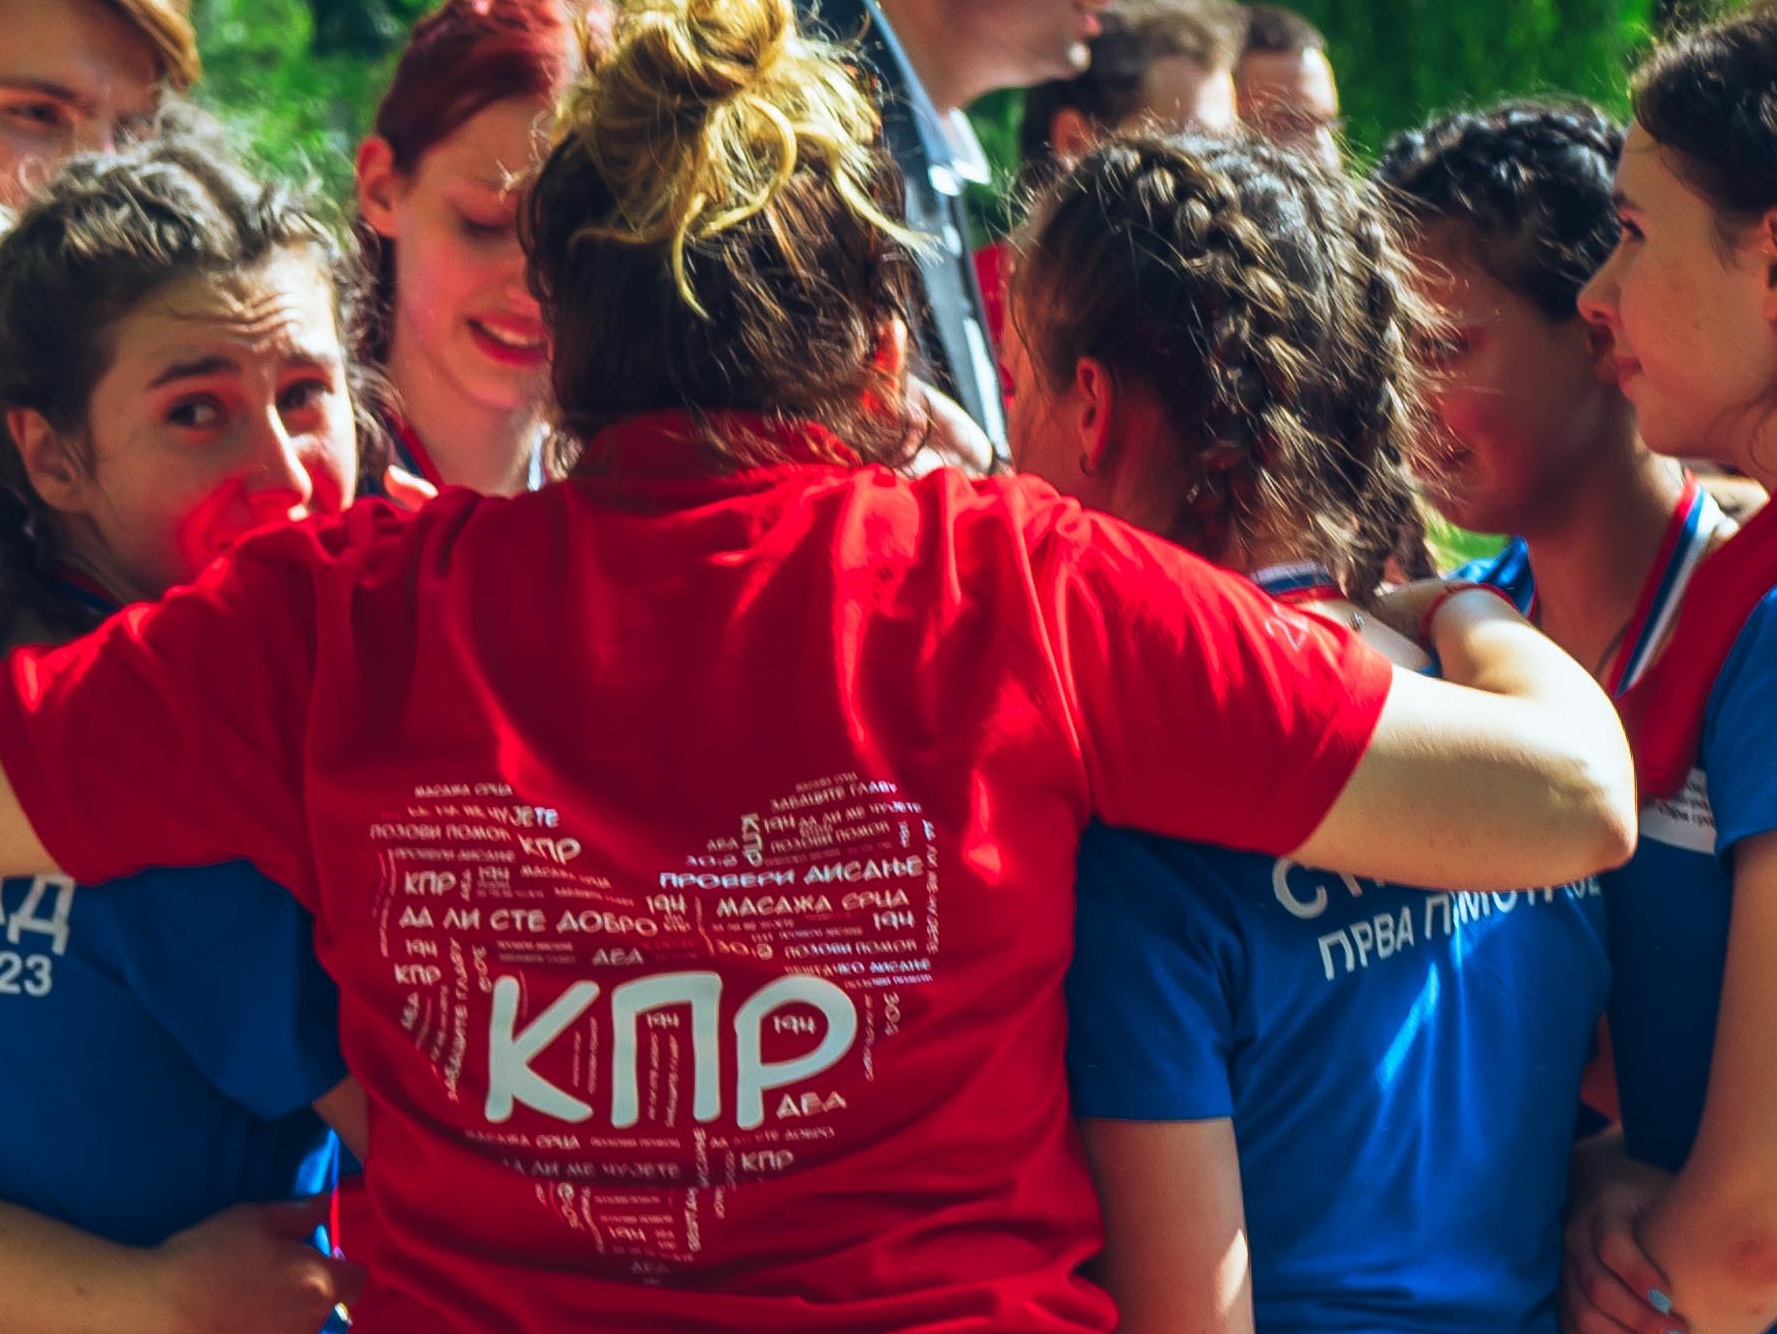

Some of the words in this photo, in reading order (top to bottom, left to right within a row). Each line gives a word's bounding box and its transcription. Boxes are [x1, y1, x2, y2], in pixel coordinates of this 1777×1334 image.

[517, 833, 582, 866] КПР
[404, 869, 457, 897] КПР
[659, 868, 796, 890] ПРОВЕРИ
[715, 894, 833, 918] МАСАЖА
[398, 904, 436, 930] ДА
[442, 906, 482, 931] ЛИ
[488, 907, 548, 933] СТЕ
[555, 908, 659, 938] ДОБРО
[1318, 905, 1415, 981] ПРВА
[393, 962, 443, 987] КПР
[484, 970, 858, 1129] КПР
[740, 1148, 795, 1172] КПР
